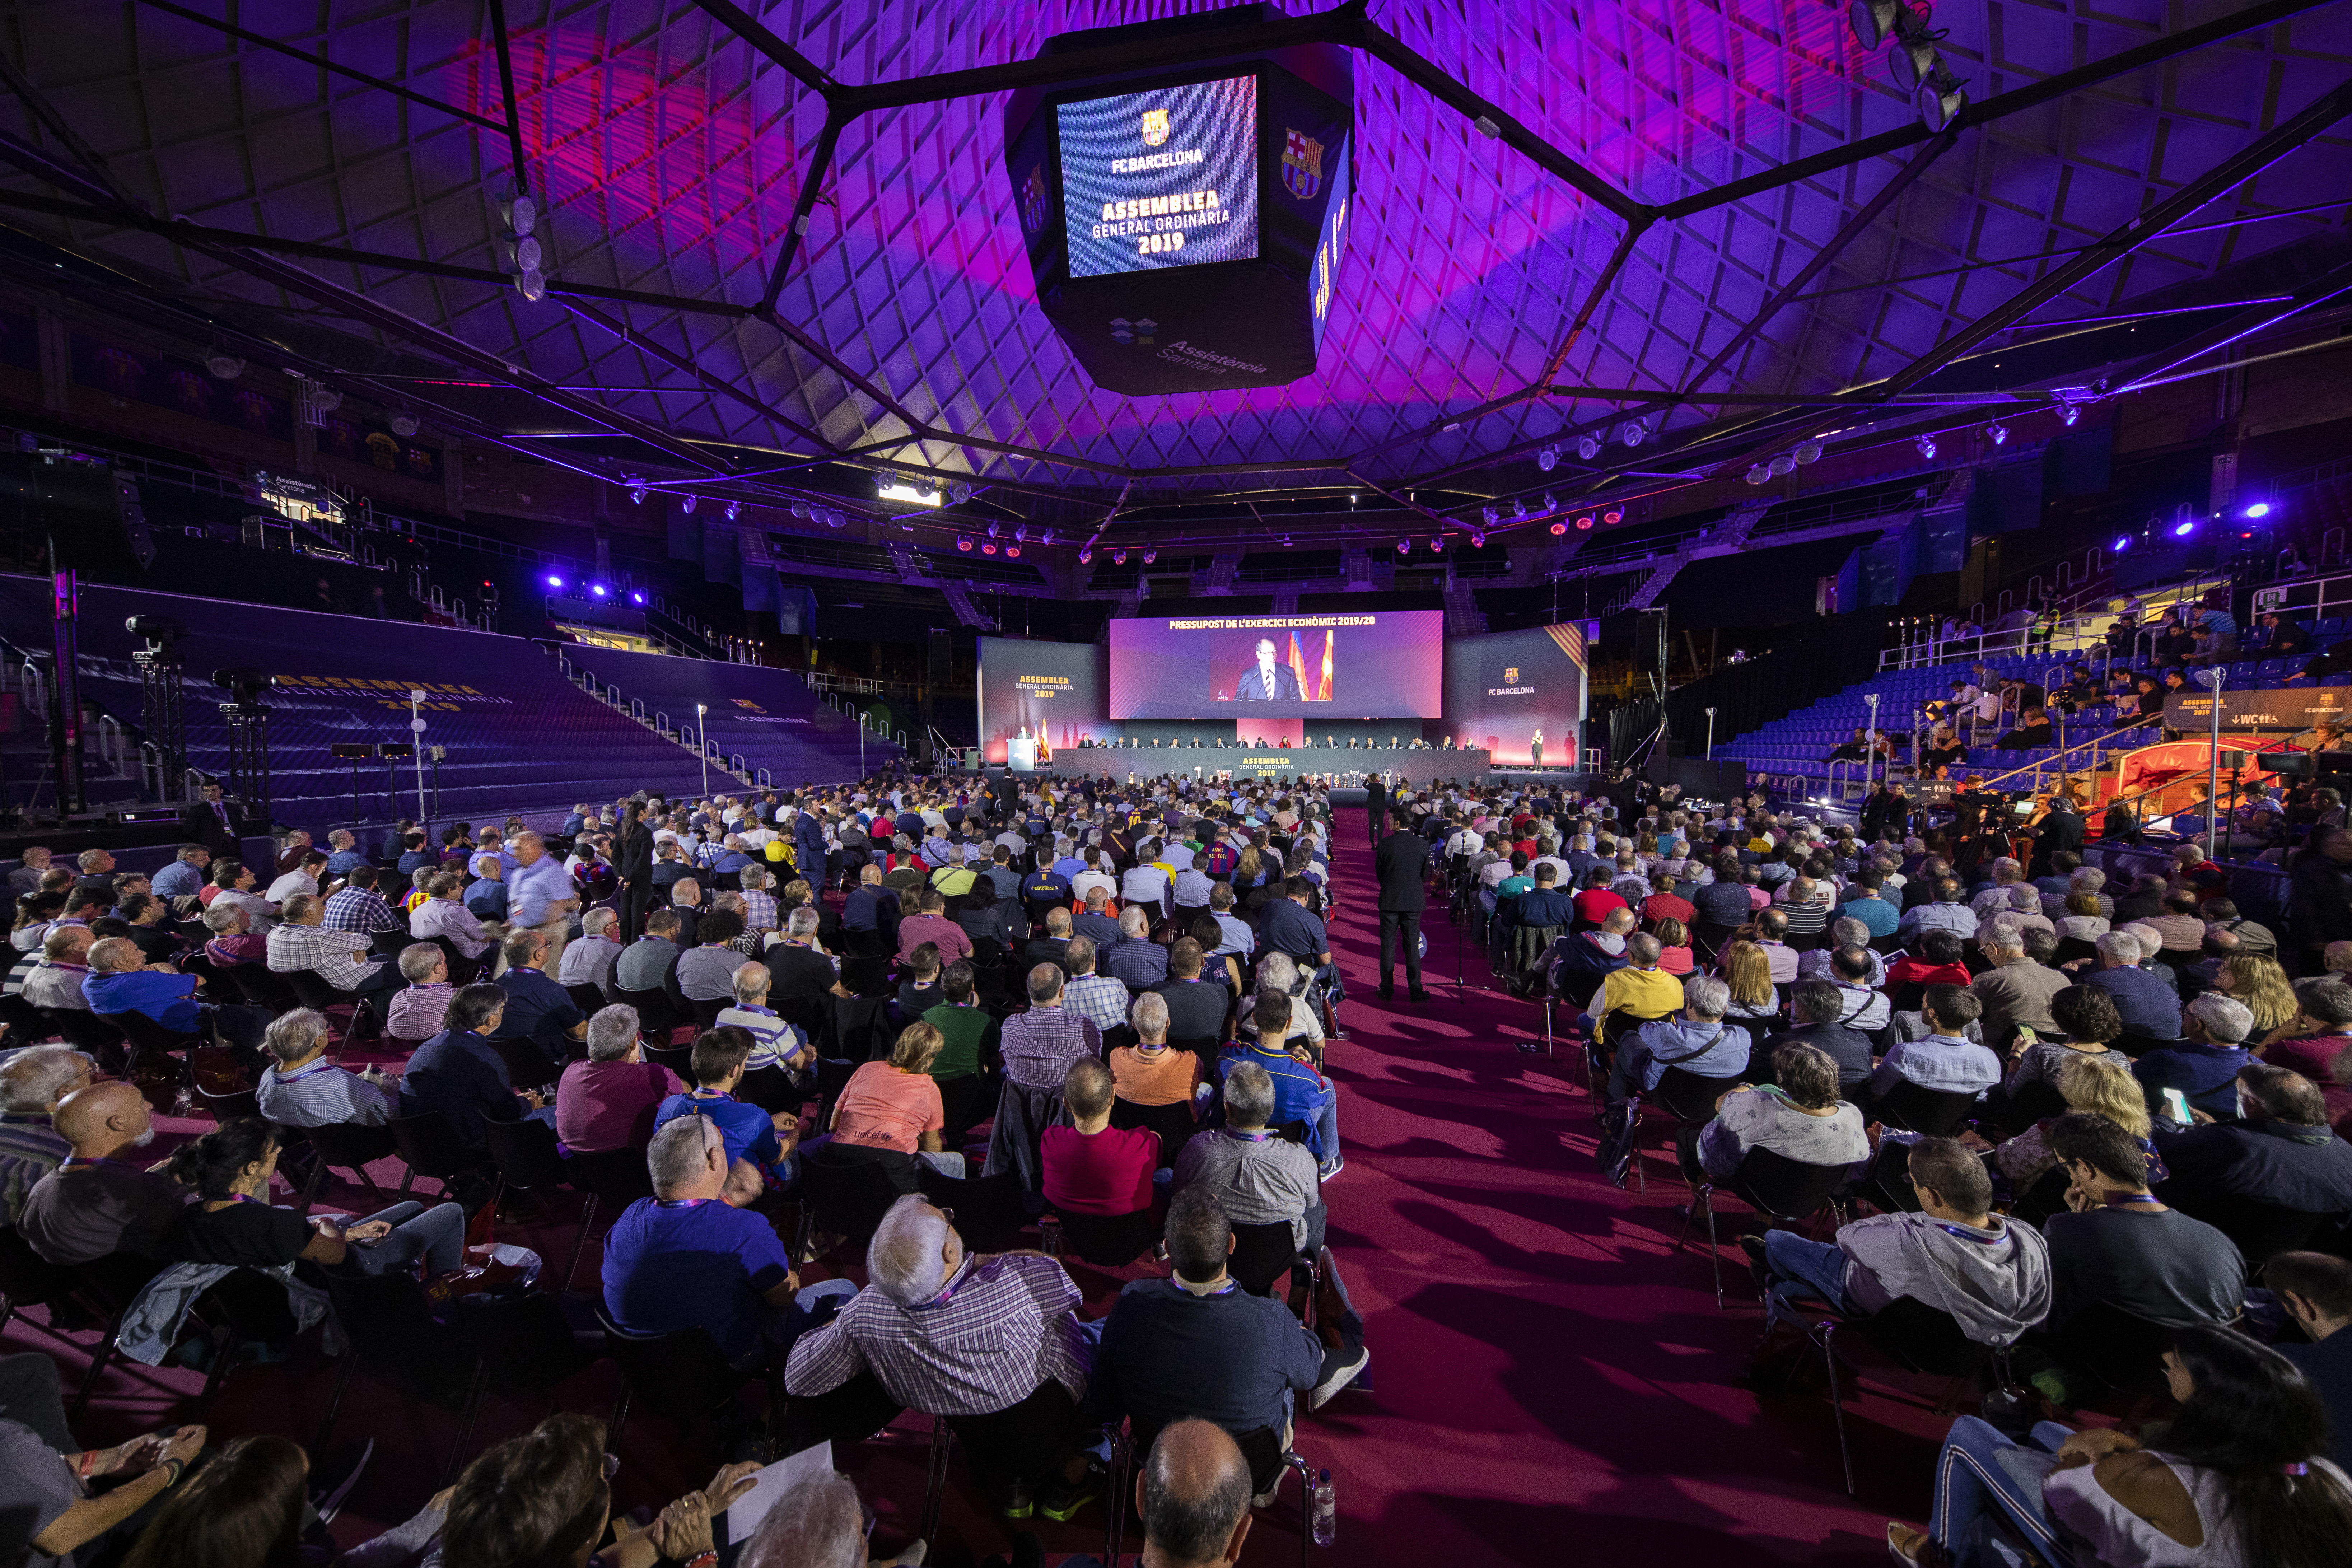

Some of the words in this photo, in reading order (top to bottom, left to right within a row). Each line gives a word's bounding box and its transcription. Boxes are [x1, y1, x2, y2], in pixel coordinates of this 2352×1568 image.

[1112, 159, 1128, 174] FC
[1128, 149, 1203, 172] BARCELONA
[1102, 190, 1219, 222] ASSEMBLEA
[1092, 219, 1151, 239] GENERAL
[1155, 209, 1229, 231] ORDINÀRIA
[1138, 232, 1184, 255] 2019
[1156, 348, 1227, 374] Sanitària
[1168, 340, 1267, 374] Assistència
[276, 476, 316, 490] Assistència
[276, 482, 305, 493] Sanitària
[1169, 620, 1225, 629] PRESSUPOST
[1226, 620, 1237, 628] DE
[1238, 618, 1287, 628] L'EXERCICI
[1288, 616, 1336, 627] ECONÒMIC
[1338, 616, 1375, 626] 2019/20
[275, 675, 484, 695] ASSEMBLEA
[1020, 676, 1069, 684] ASSEMBLEA
[270, 686, 391, 698] GENERAL
[395, 691, 513, 704] ODINÀRIA
[1497, 686, 1535, 695] BARCELONA
[377, 700, 461, 711] 2019
[2240, 714, 2258, 724] WC
[1128, 816, 1141, 830] 10
[854, 1130, 882, 1139] unicef
